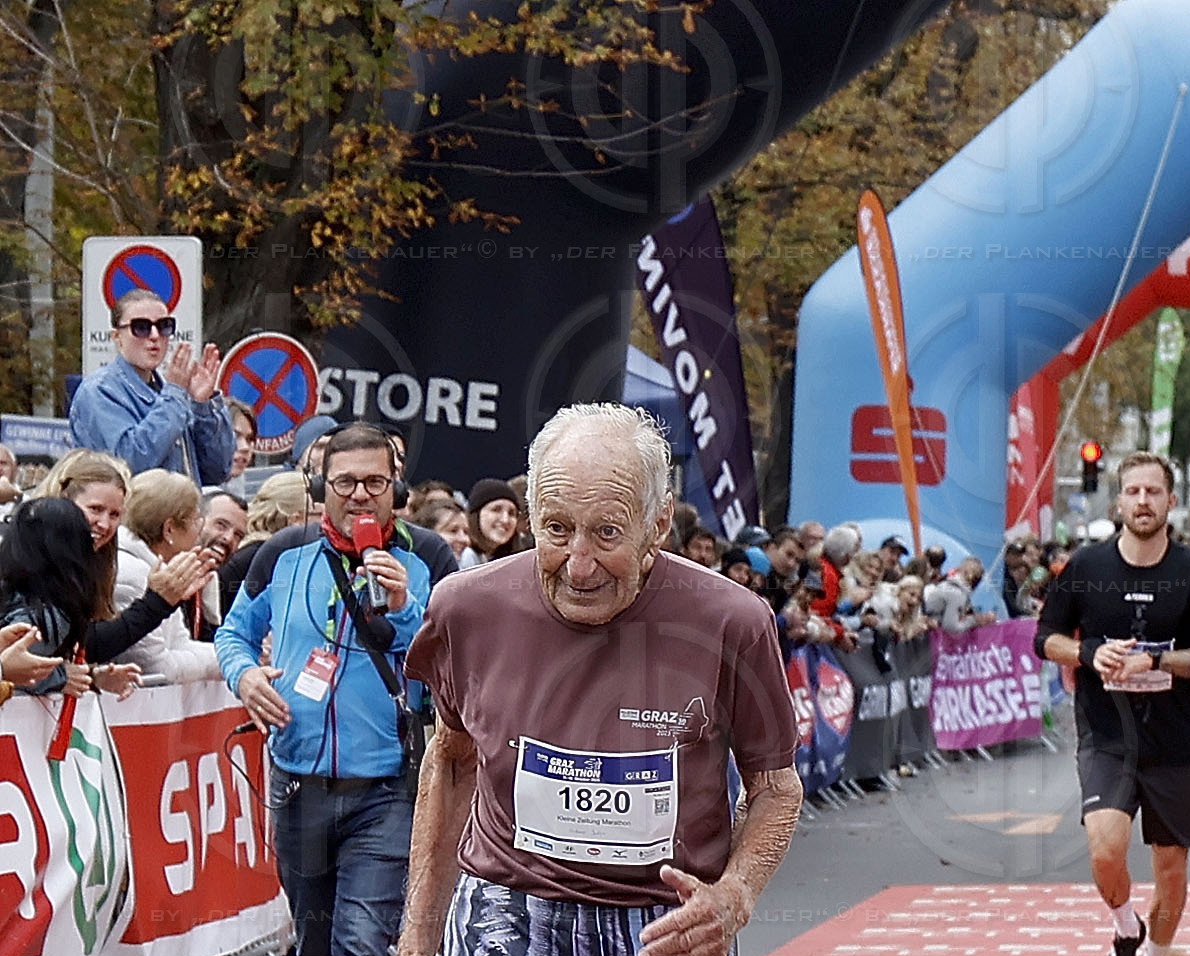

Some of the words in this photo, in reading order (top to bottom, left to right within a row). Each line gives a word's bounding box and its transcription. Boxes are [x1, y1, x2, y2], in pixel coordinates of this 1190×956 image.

[318, 366, 499, 431] STORE
[251, 429, 295, 451] NFANG
[640, 709, 679, 724] GRAZ
[547, 764, 602, 778] MARATHON
[549, 756, 575, 769] GRAZ
[558, 786, 632, 814] 1820
[159, 743, 271, 895] SPA
[556, 815, 576, 823] Kleine
[576, 816, 601, 826] Zeitung
[601, 818, 632, 827] Marathon
